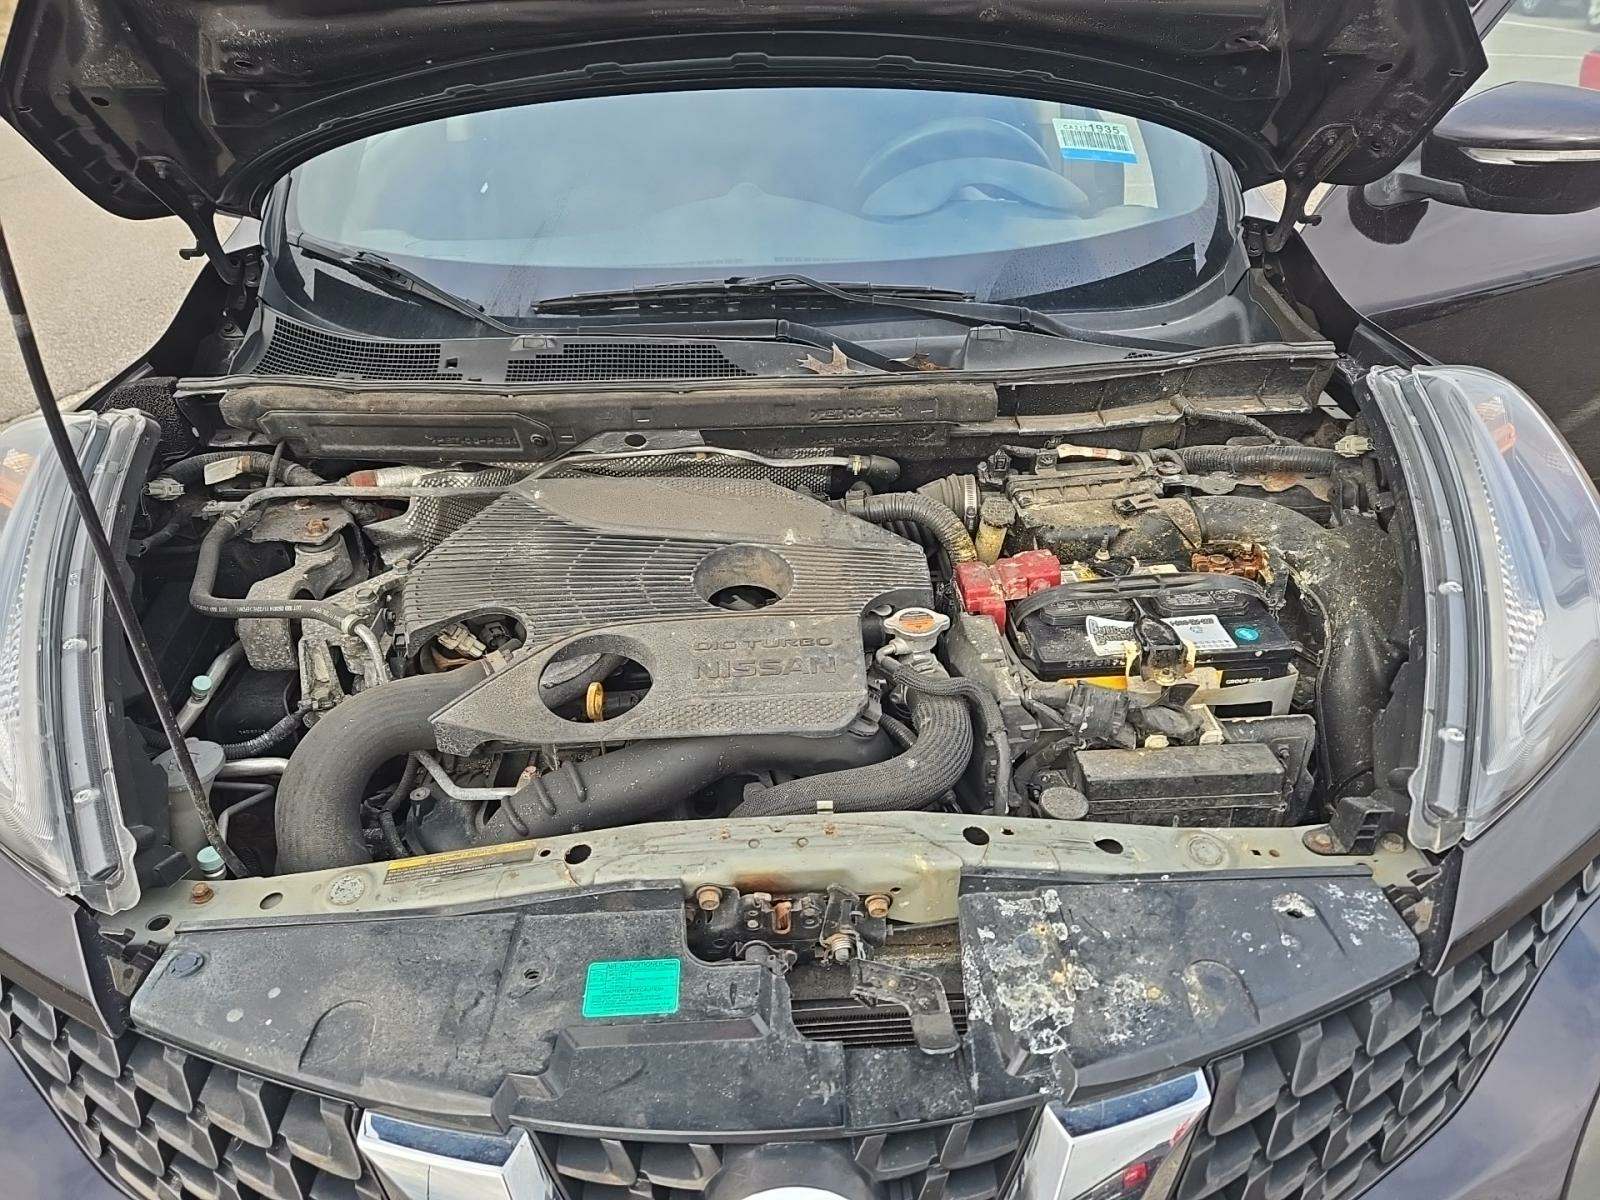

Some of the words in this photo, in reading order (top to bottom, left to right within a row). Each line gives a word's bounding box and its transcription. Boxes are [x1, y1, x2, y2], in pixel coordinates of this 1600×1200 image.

[695, 640, 738, 651] DIG
[743, 636, 834, 649] TURBO
[694, 655, 838, 680] NISSAN
